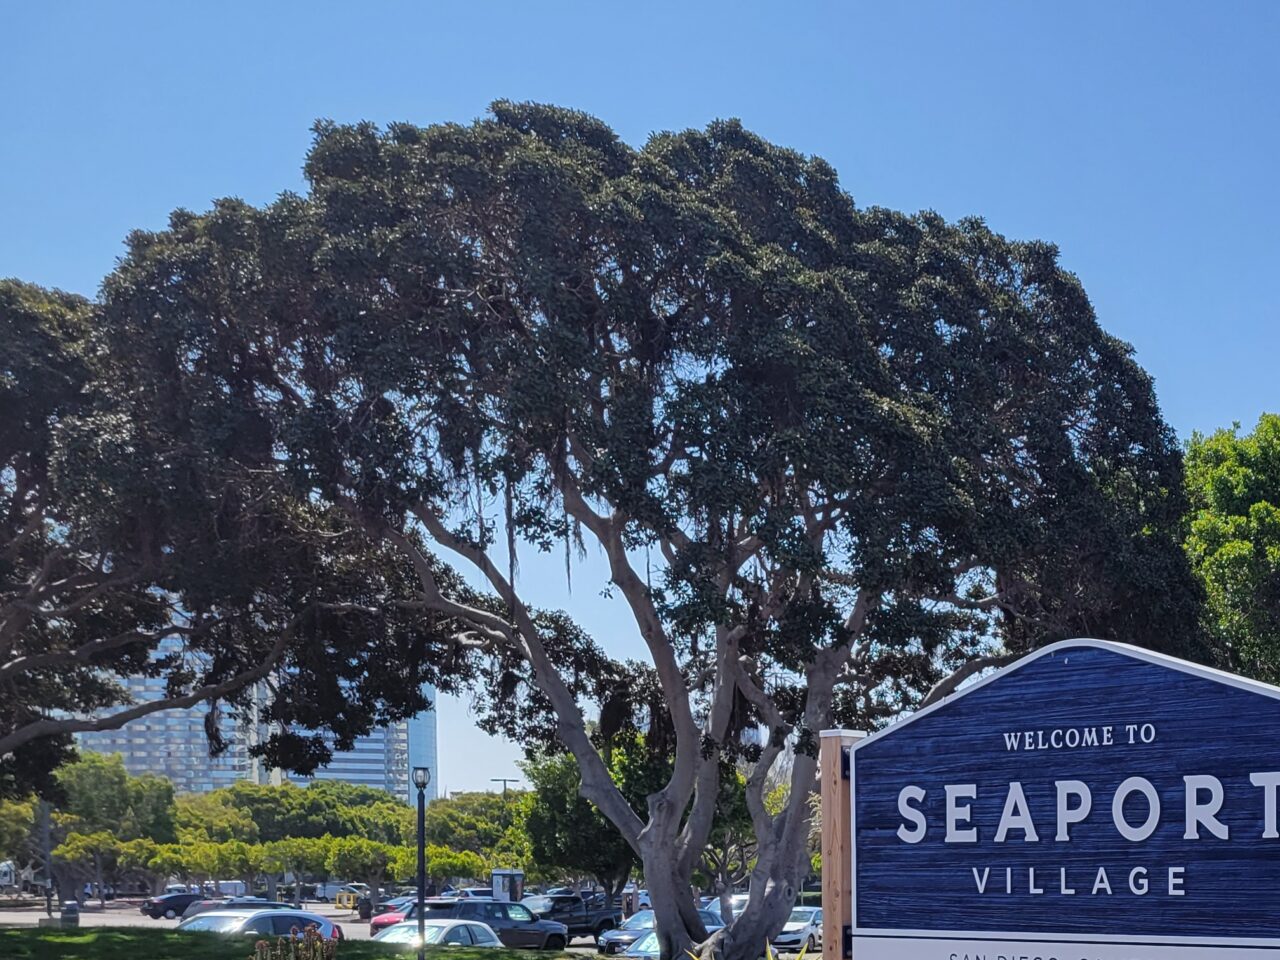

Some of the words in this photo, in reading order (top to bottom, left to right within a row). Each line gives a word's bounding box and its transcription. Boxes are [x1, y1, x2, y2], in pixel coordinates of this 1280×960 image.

[1003, 726, 1114, 751] WELCOME
[1125, 723, 1156, 744] TO
[972, 867, 1187, 896] VILLAGE
